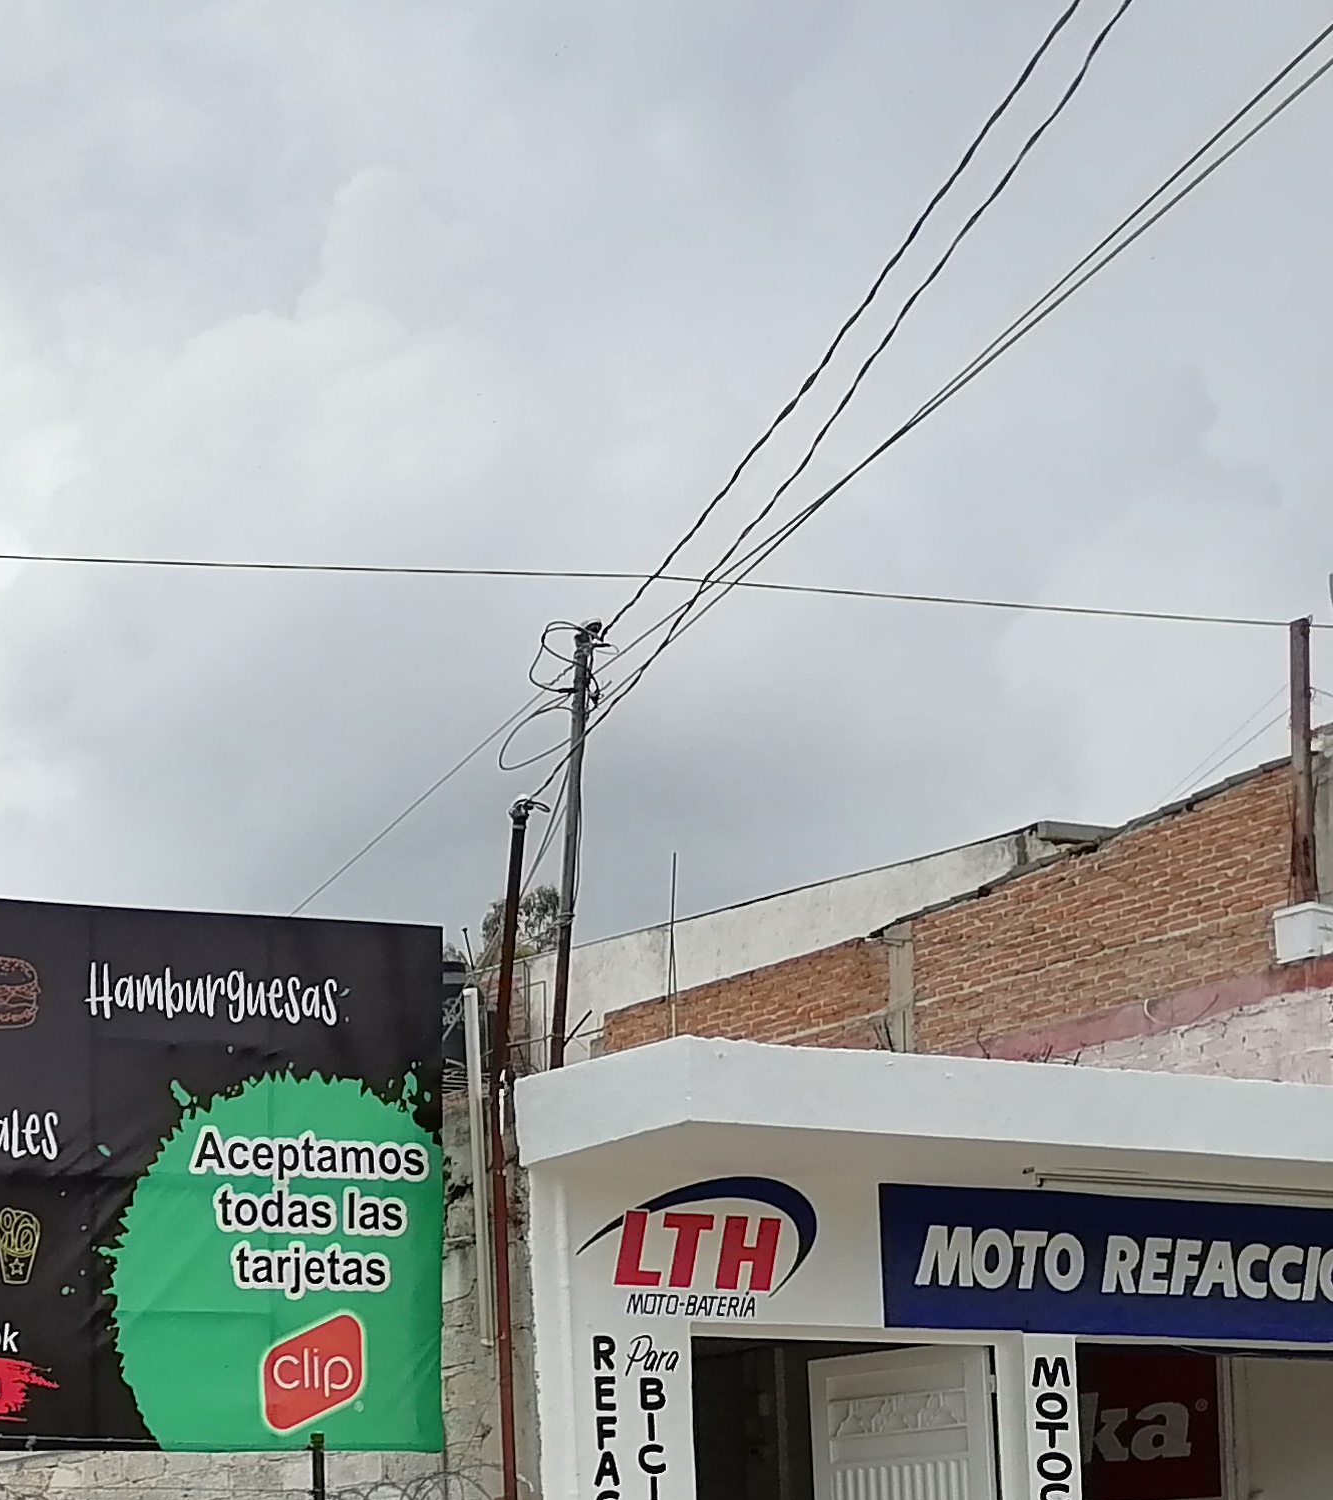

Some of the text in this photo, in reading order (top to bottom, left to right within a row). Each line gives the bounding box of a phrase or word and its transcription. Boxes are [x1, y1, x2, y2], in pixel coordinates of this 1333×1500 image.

[84, 961, 339, 1026] Hamburguesas
[193, 1131, 426, 1183] Aceptamos
[217, 1191, 404, 1233] todas las
[234, 1245, 387, 1295] tarjetas
[613, 1209, 782, 1292] LTH
[915, 1224, 1085, 1292] MOTO
[626, 1291, 757, 1318] MOTO-BATERÍA
[272, 1346, 354, 1395] clip
[624, 1334, 680, 1377] Para
[1080, 1391, 1192, 1463] ka
